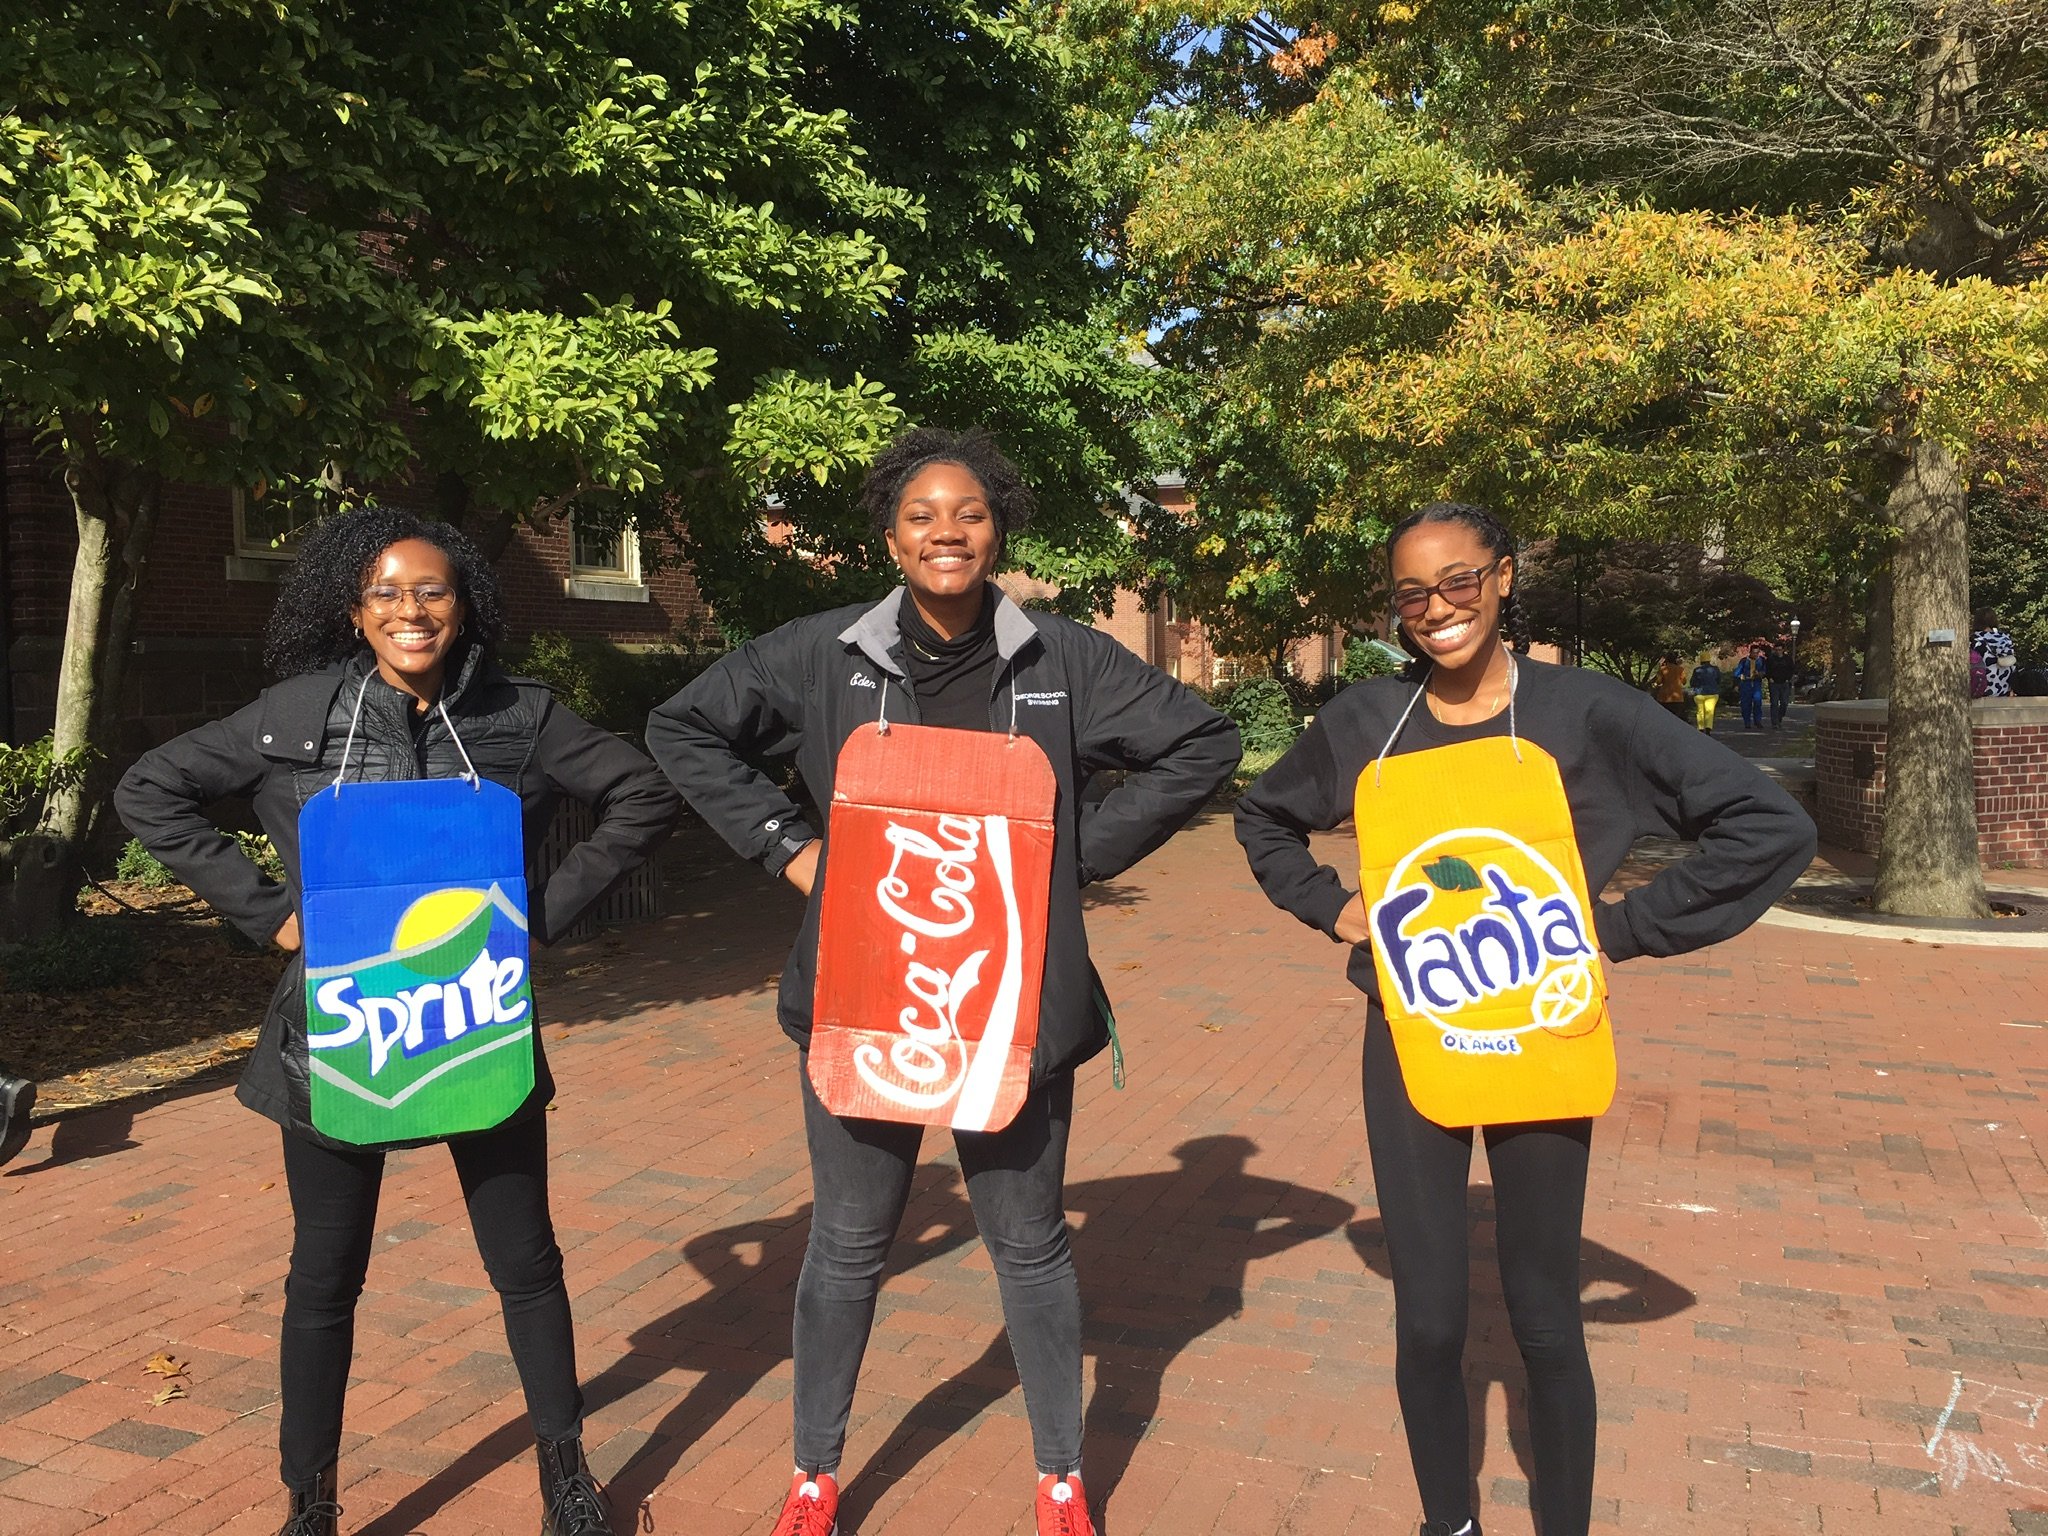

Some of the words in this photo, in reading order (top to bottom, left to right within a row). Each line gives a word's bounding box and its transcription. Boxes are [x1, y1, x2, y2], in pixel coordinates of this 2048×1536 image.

[850, 672, 877, 689] Eden
[1040, 691, 1068, 699] SCHOOL
[853, 814, 990, 1109] Coca-Cola
[1375, 868, 1592, 1008] Fanta
[307, 947, 527, 1077] Sprite
[1443, 1034, 1519, 1053] ORANGE
